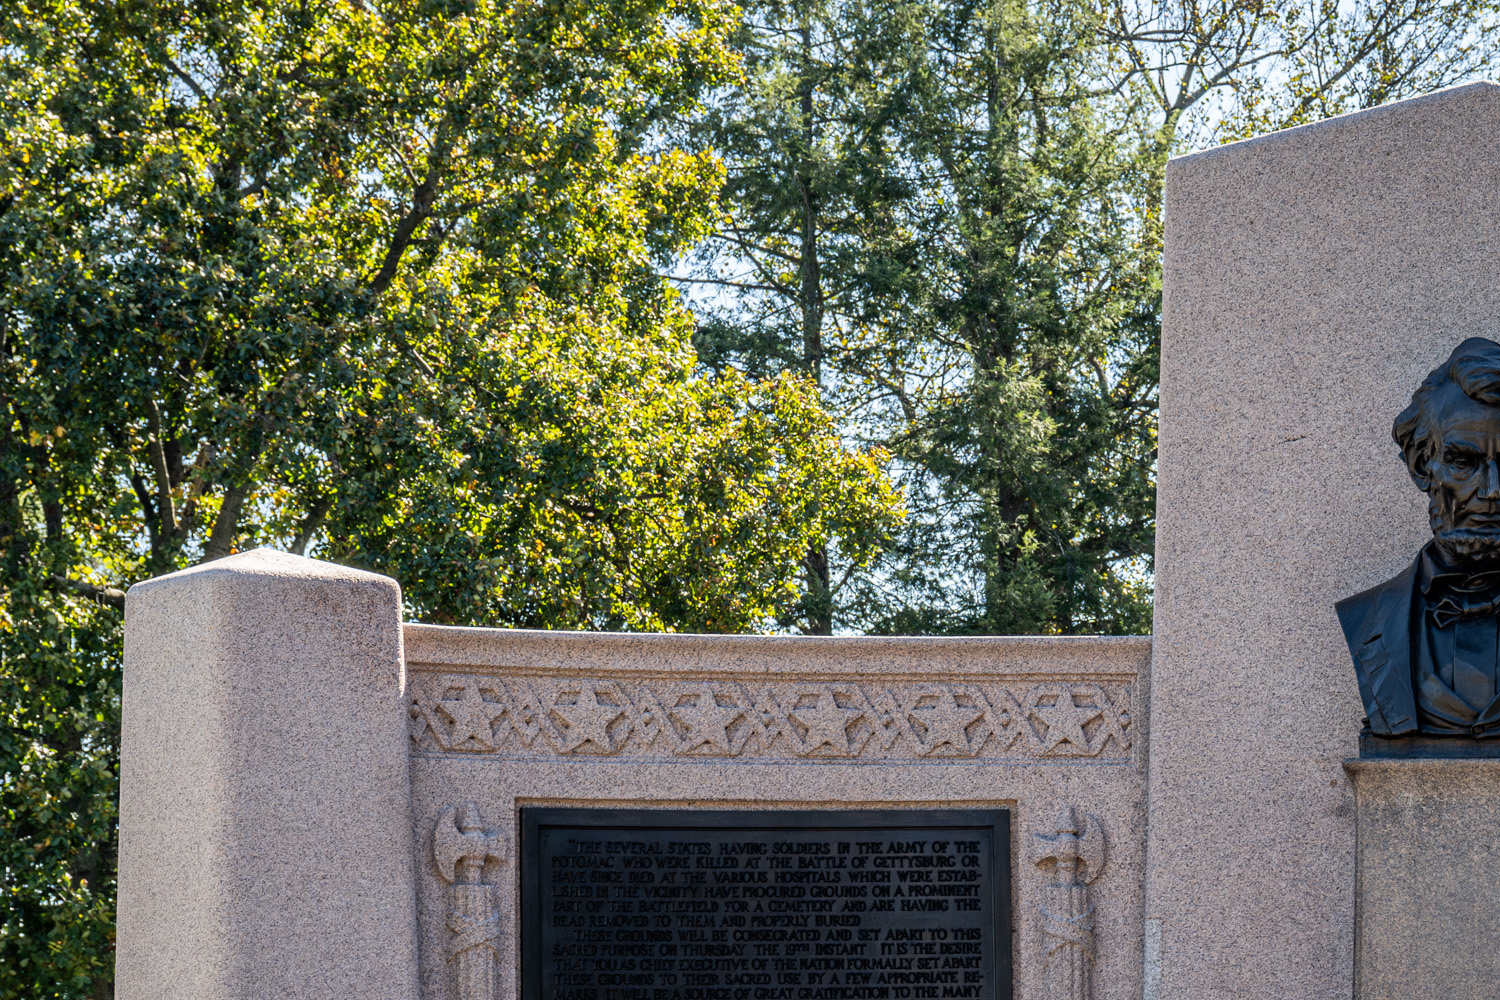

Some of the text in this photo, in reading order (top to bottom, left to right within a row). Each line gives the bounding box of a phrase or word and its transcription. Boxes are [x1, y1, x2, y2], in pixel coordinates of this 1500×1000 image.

[606, 842, 662, 854] SEVERAL
[668, 842, 712, 854] STATES
[719, 842, 767, 854] HAVING
[772, 842, 830, 854] SOLDIERS
[837, 842, 850, 854] IN
[856, 842, 883, 854] THE
[887, 842, 926, 854] ARMY
[931, 841, 949, 854] OF
[954, 841, 980, 853] THE
[552, 855, 979, 869] POTOMAC WHO WERE KILLED AT THE BATTLE OF GETTYSBURG OR
[552, 870, 983, 883] HAVE SINCE DIED AT THE VARIOUS HOSPITALS WHICH WERE ESTAB-
[553, 914, 861, 927] DEAD REMOVED TO THEM AND PROPERLY BURIED
[574, 928, 981, 942] THESE GROUNDS WILL BE CONSECRATED AND SET APART TO THIS
[554, 971, 984, 986] THESE GROUNDS TO THEIR SACRED USE BY A FEW APPROPRIATE RE-
